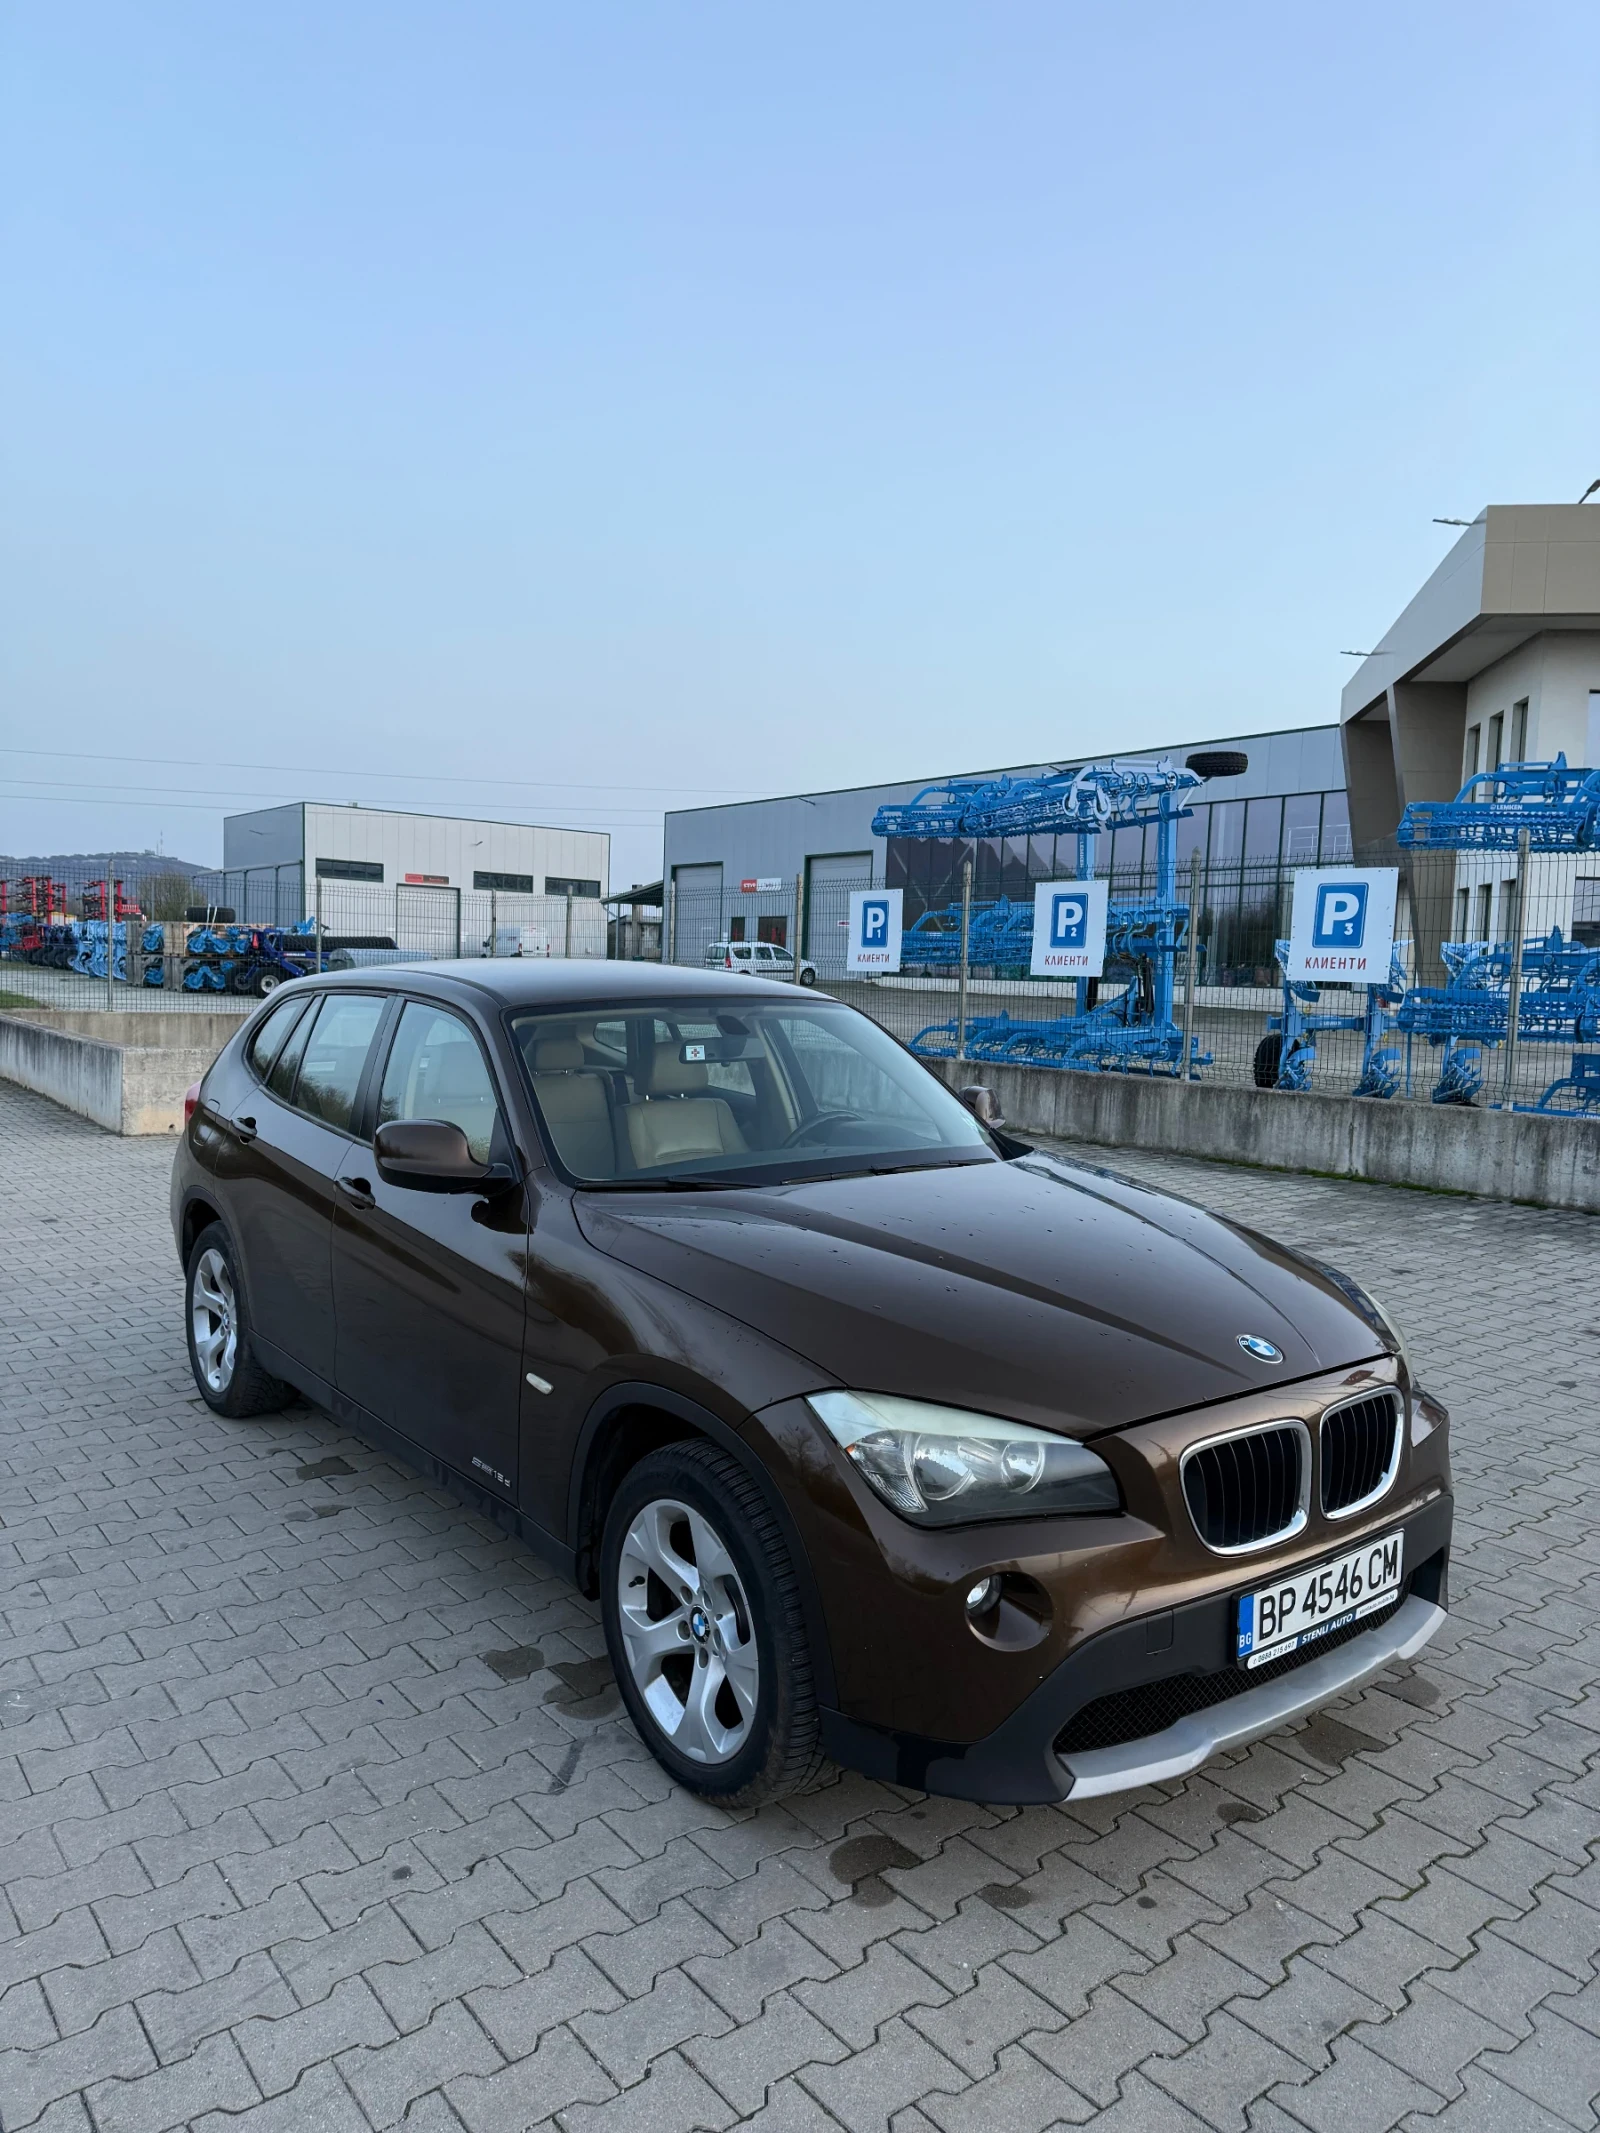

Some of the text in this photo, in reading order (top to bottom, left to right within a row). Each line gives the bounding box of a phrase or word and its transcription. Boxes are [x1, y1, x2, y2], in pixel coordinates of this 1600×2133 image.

[857, 954, 890, 963] КЛИЕНТИ
[1044, 955, 1088, 966] КЛИЕНТИ
[1305, 957, 1367, 970] КЛИЕНТИ
[1259, 1540, 1398, 1640] BP 4546 CM
[1302, 1613, 1353, 1644] STENLI AUTO
[1239, 1632, 1252, 1648] BG
